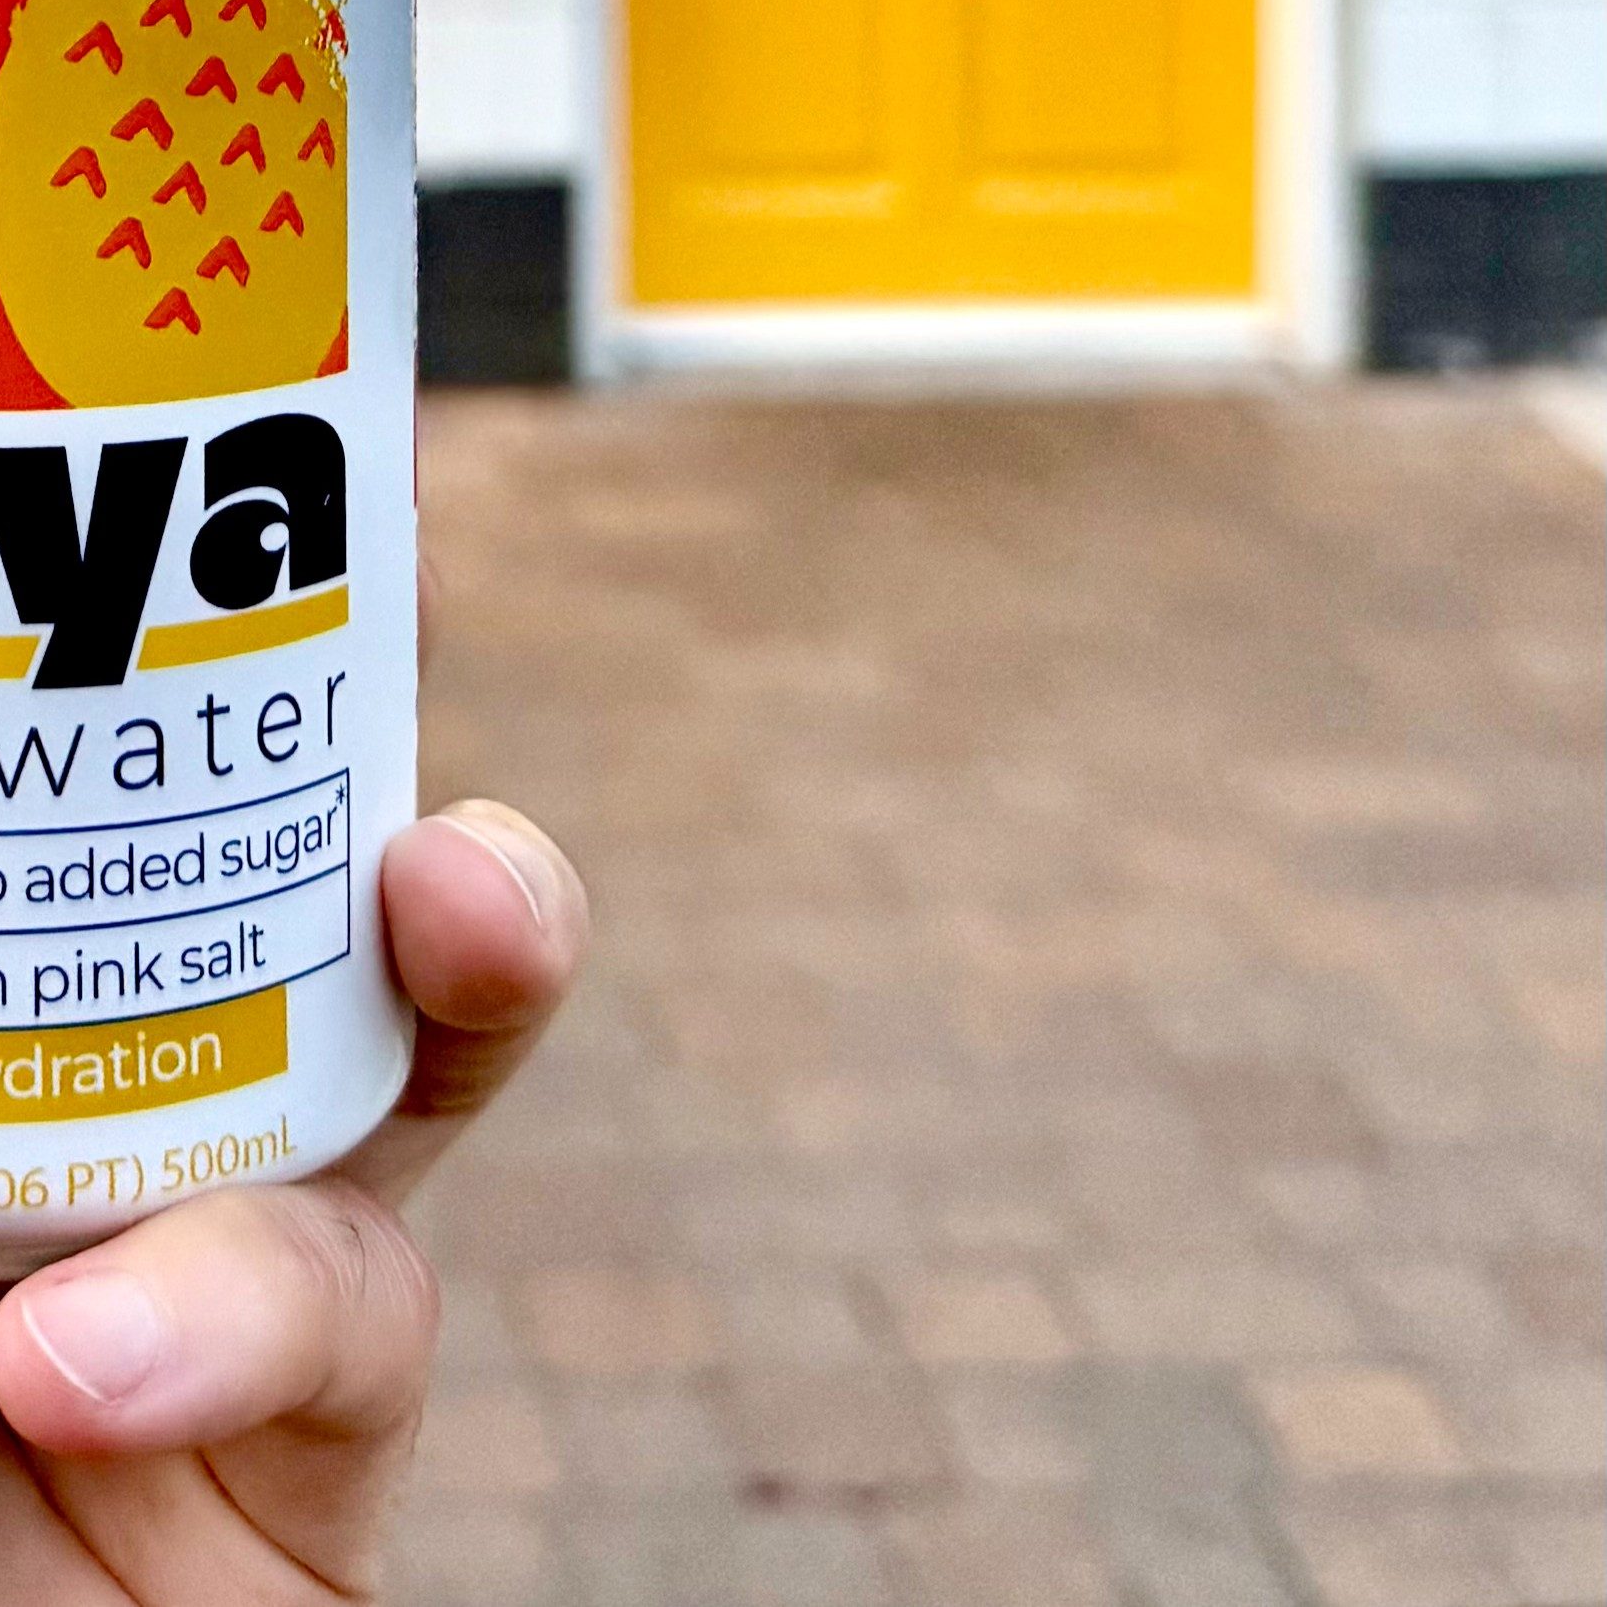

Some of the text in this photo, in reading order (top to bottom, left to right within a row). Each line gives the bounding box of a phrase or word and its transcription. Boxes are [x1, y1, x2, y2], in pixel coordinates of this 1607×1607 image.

[24, 832, 207, 902] added
[32, 942, 164, 1016] pink
[180, 921, 267, 984] salt
[66, 1154, 146, 1206] PT)
[161, 1116, 298, 1192] 500mL
